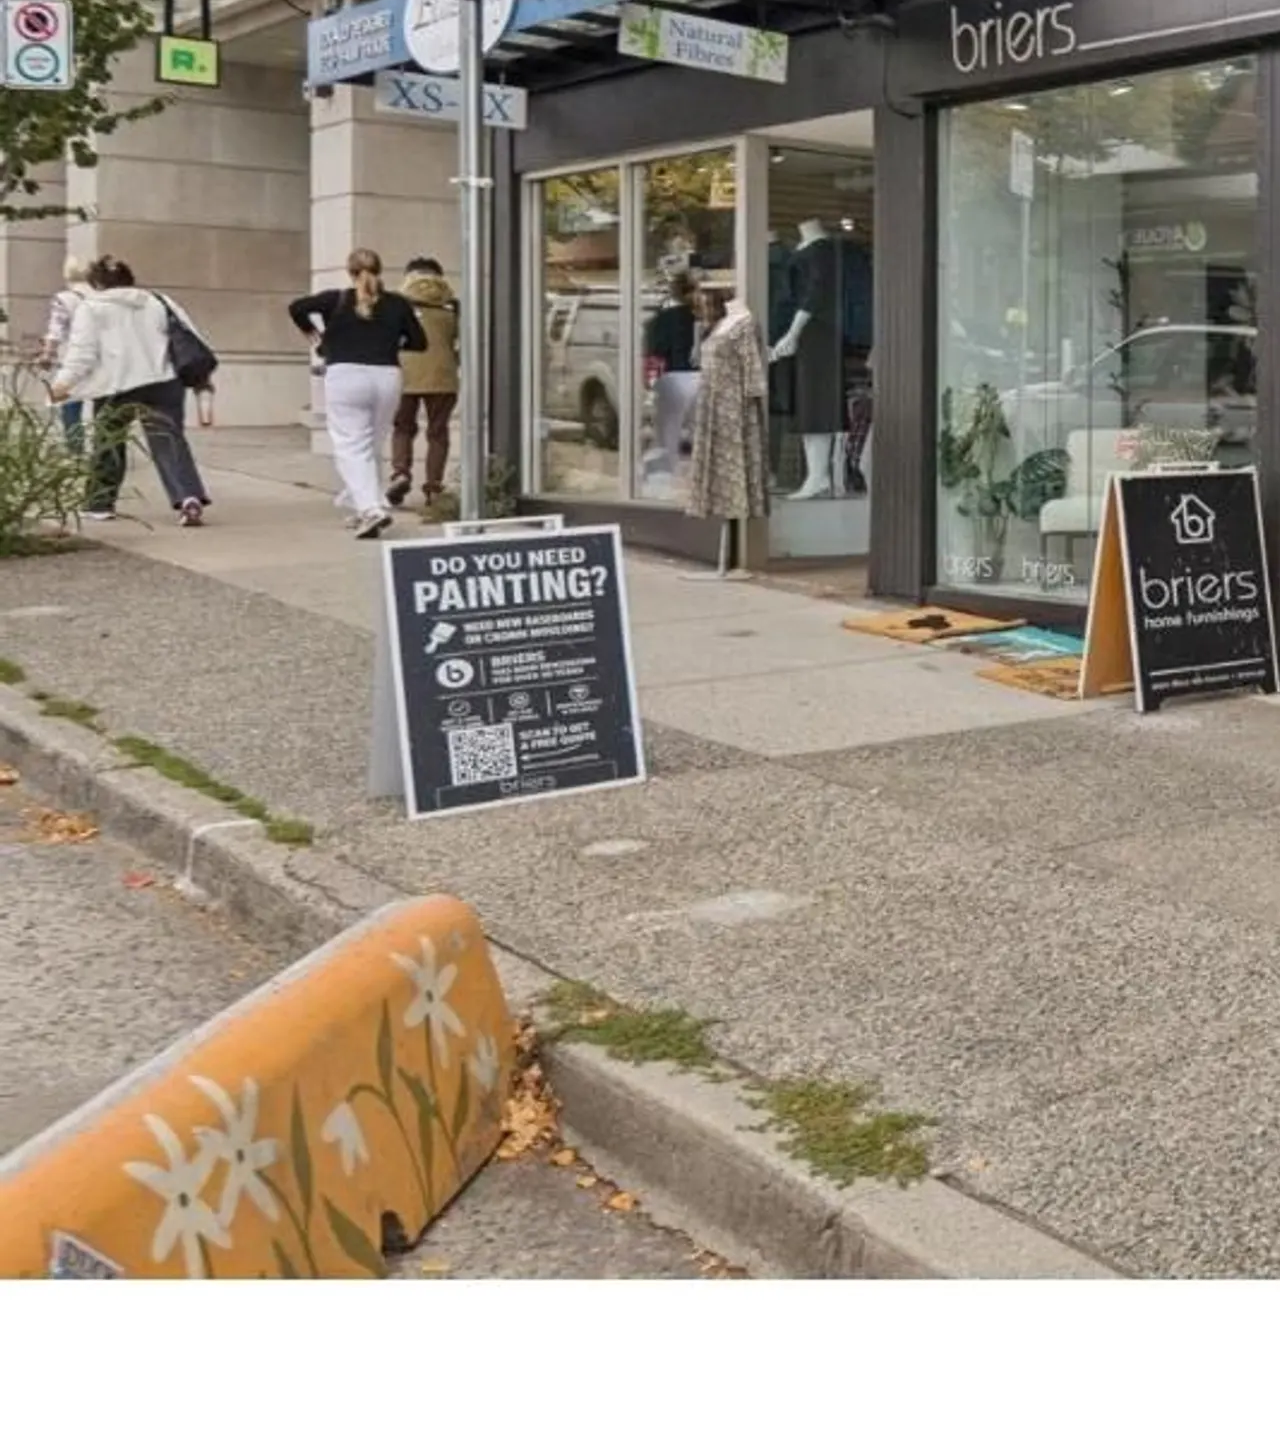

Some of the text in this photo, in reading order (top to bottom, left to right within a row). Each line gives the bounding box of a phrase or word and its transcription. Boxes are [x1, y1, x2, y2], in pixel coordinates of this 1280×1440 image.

[669, 18, 743, 49] Natural
[951, 0, 1076, 73] briers
[675, 40, 735, 68] Fibres
[430, 547, 587, 576] DO YOU NEED
[413, 566, 608, 613] PAINTING?
[1139, 566, 1258, 610] briers
[1144, 606, 1260, 630] home furnishings
